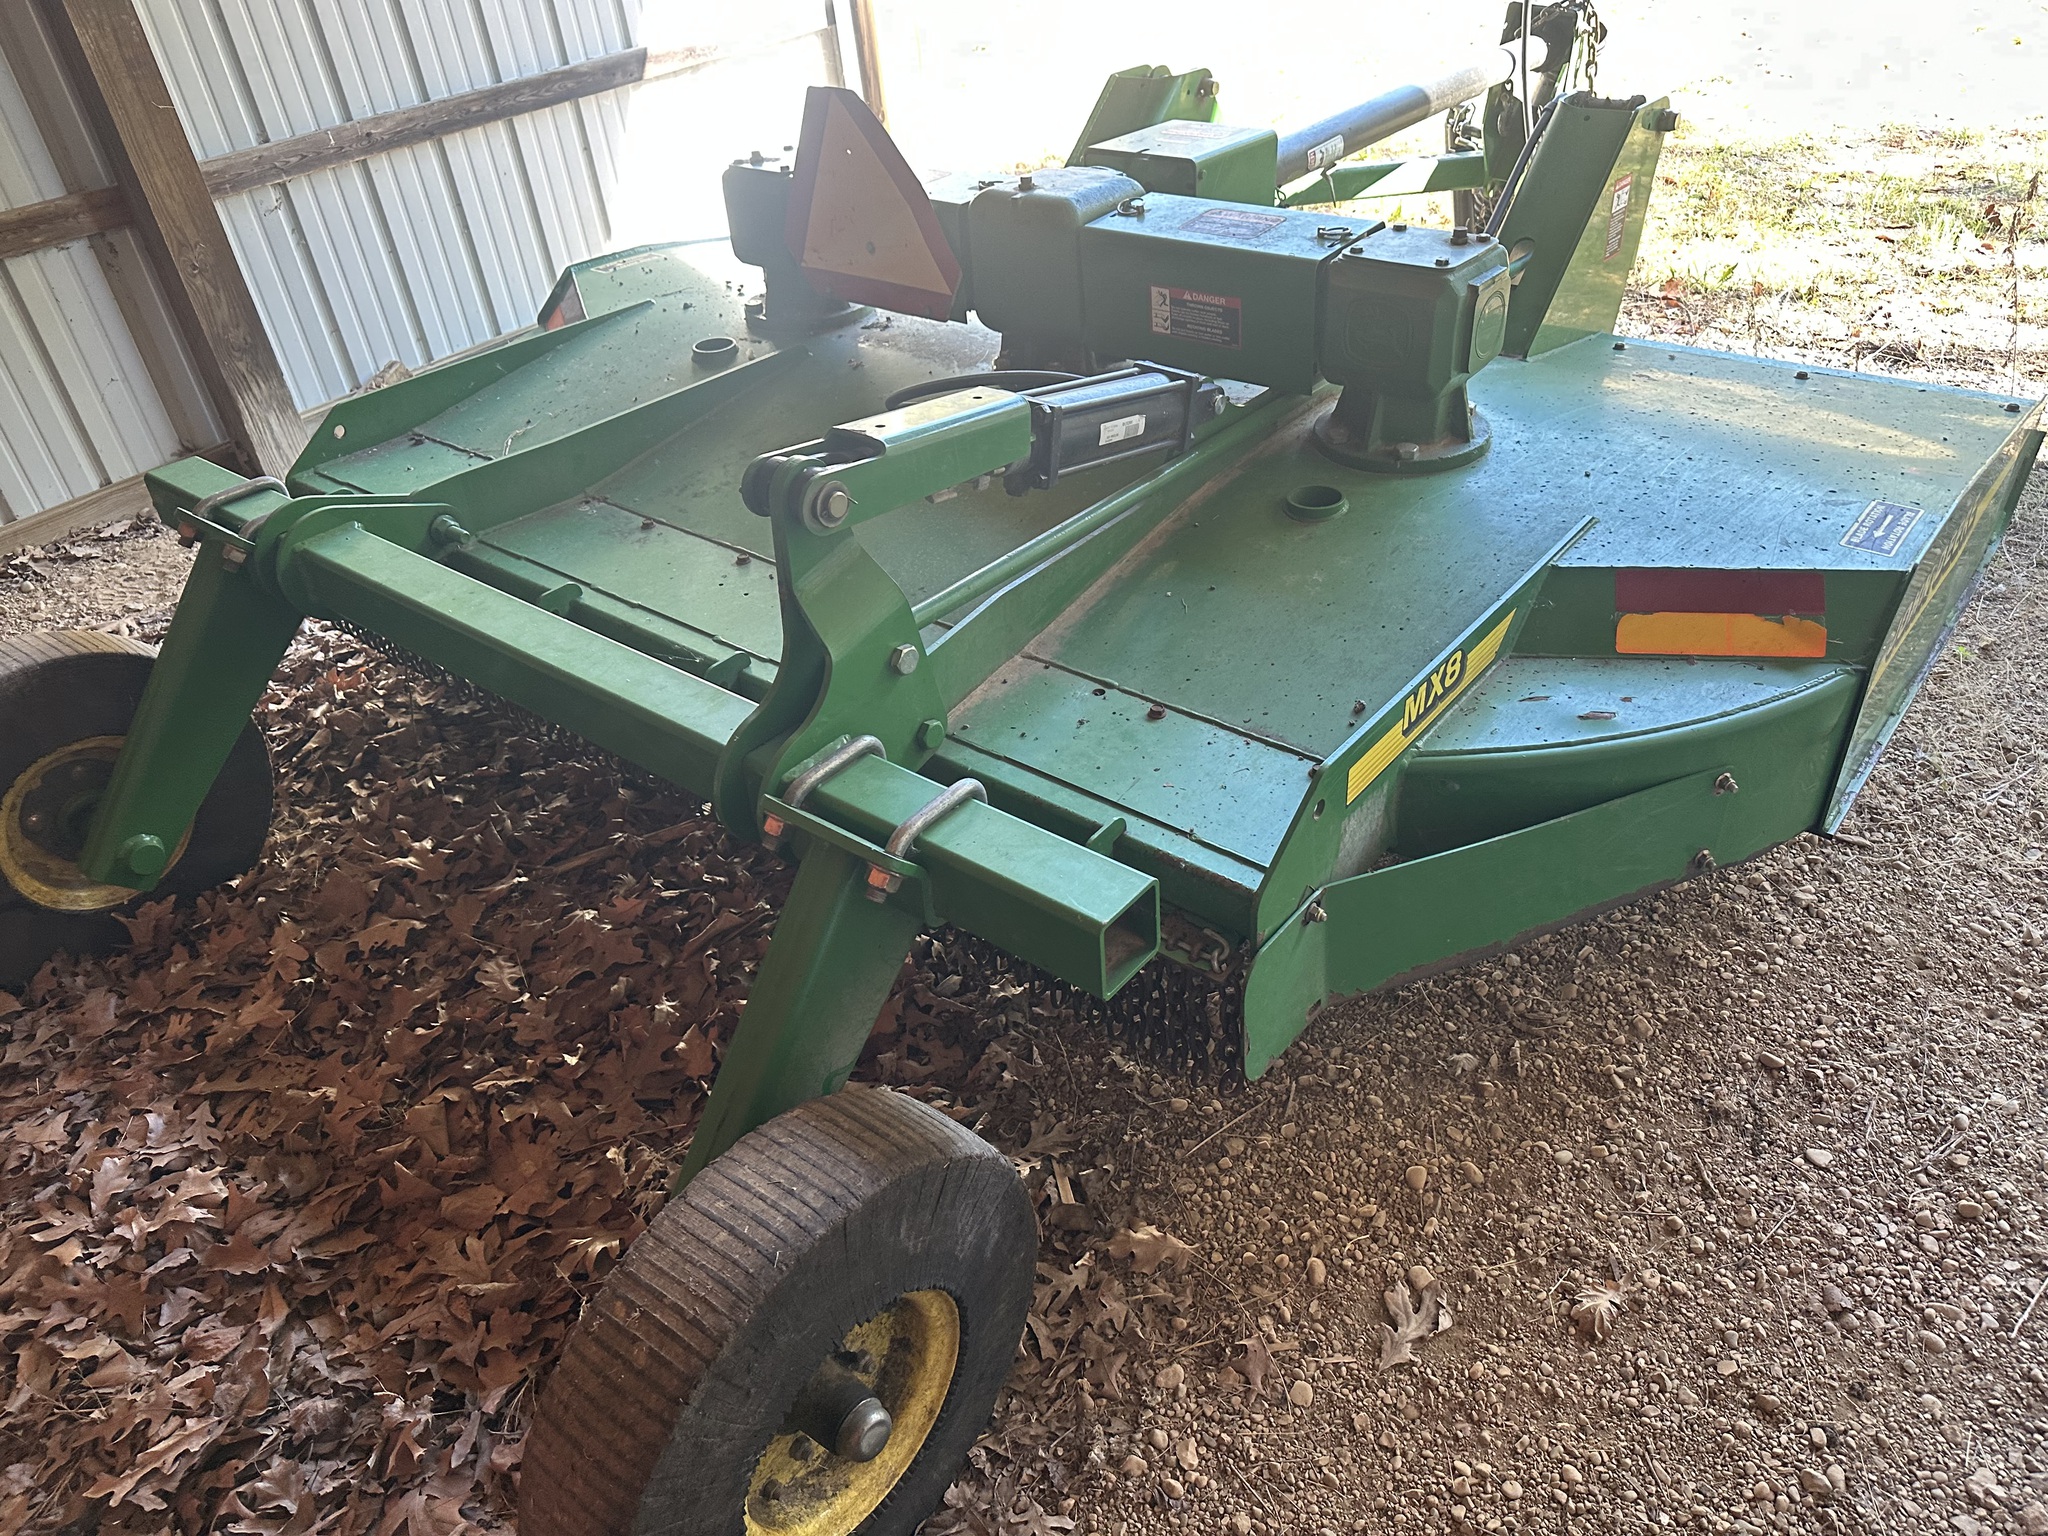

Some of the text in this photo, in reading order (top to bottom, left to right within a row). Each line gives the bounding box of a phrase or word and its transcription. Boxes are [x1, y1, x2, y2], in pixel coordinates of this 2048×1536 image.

[1192, 293, 1226, 306] DANGER
[1850, 504, 1885, 543] BLADE ROTATION
[1880, 511, 1915, 550] BLADE ROTATION
[1403, 649, 1464, 733] MX8
